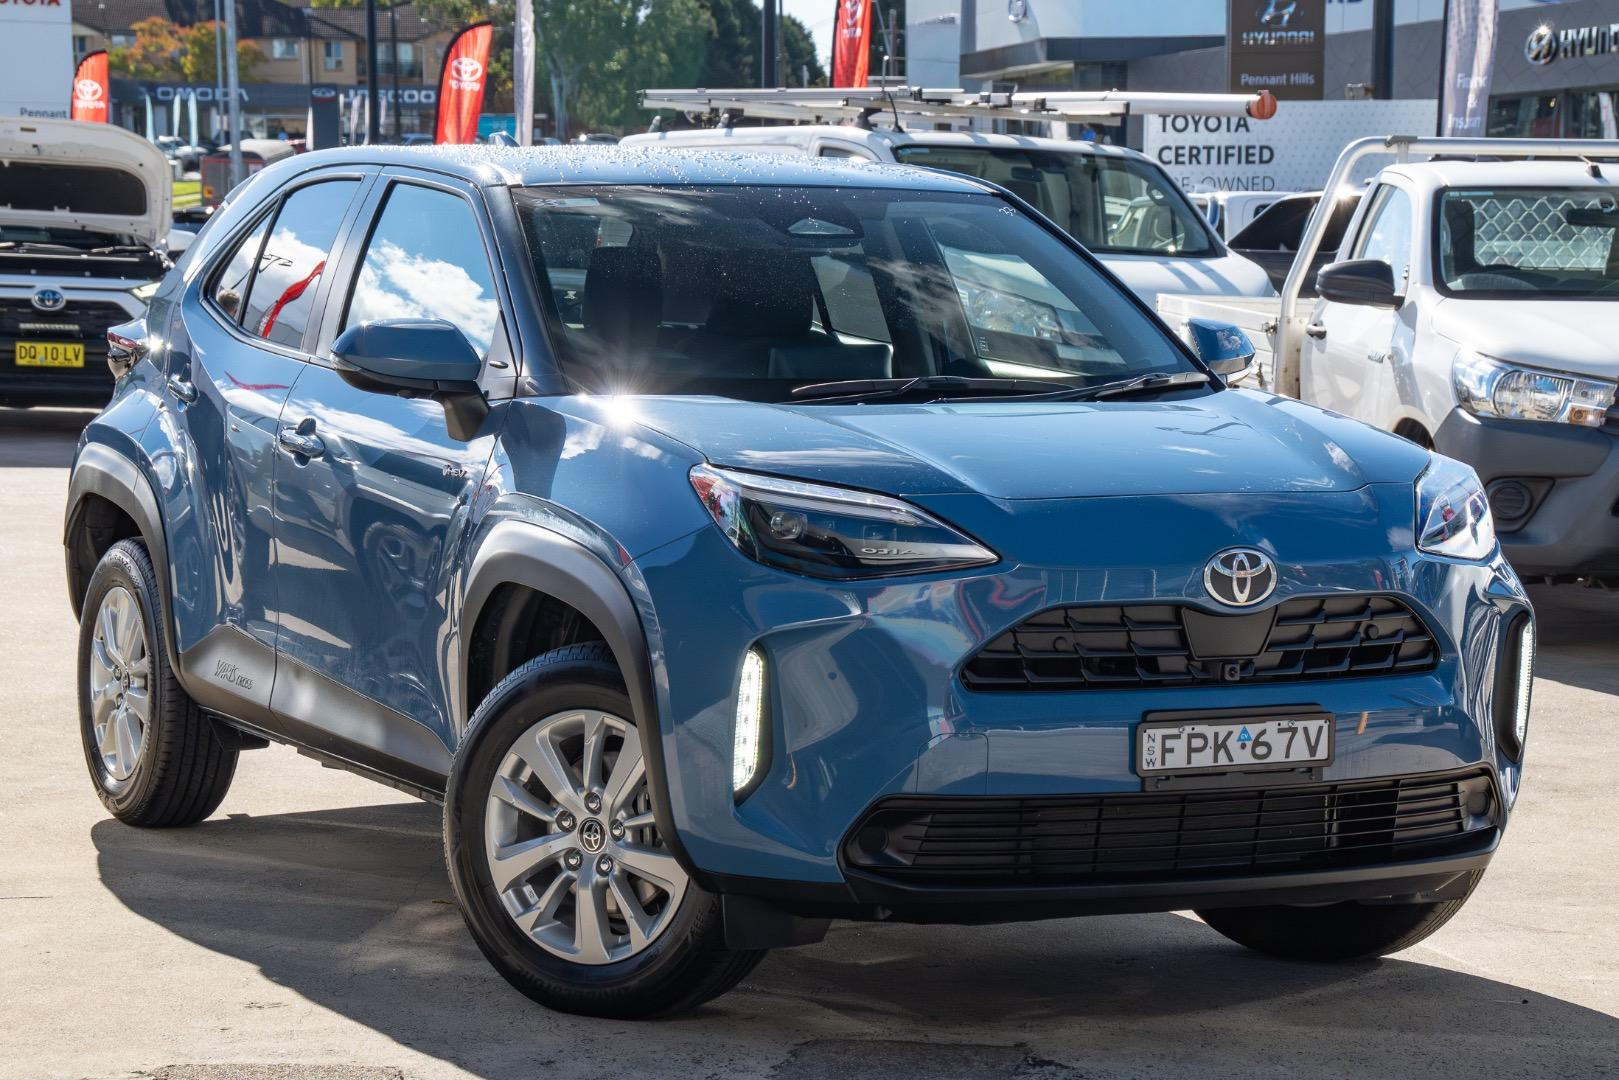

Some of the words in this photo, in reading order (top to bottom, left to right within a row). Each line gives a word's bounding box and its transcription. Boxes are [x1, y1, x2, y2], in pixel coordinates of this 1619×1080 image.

[1241, 73, 1287, 86] Pennant
[1290, 73, 1315, 85] Hills
[20, 107, 67, 118] Pennant
[1158, 114, 1250, 133] TOYOTA
[1158, 145, 1275, 165] CERTIFIED
